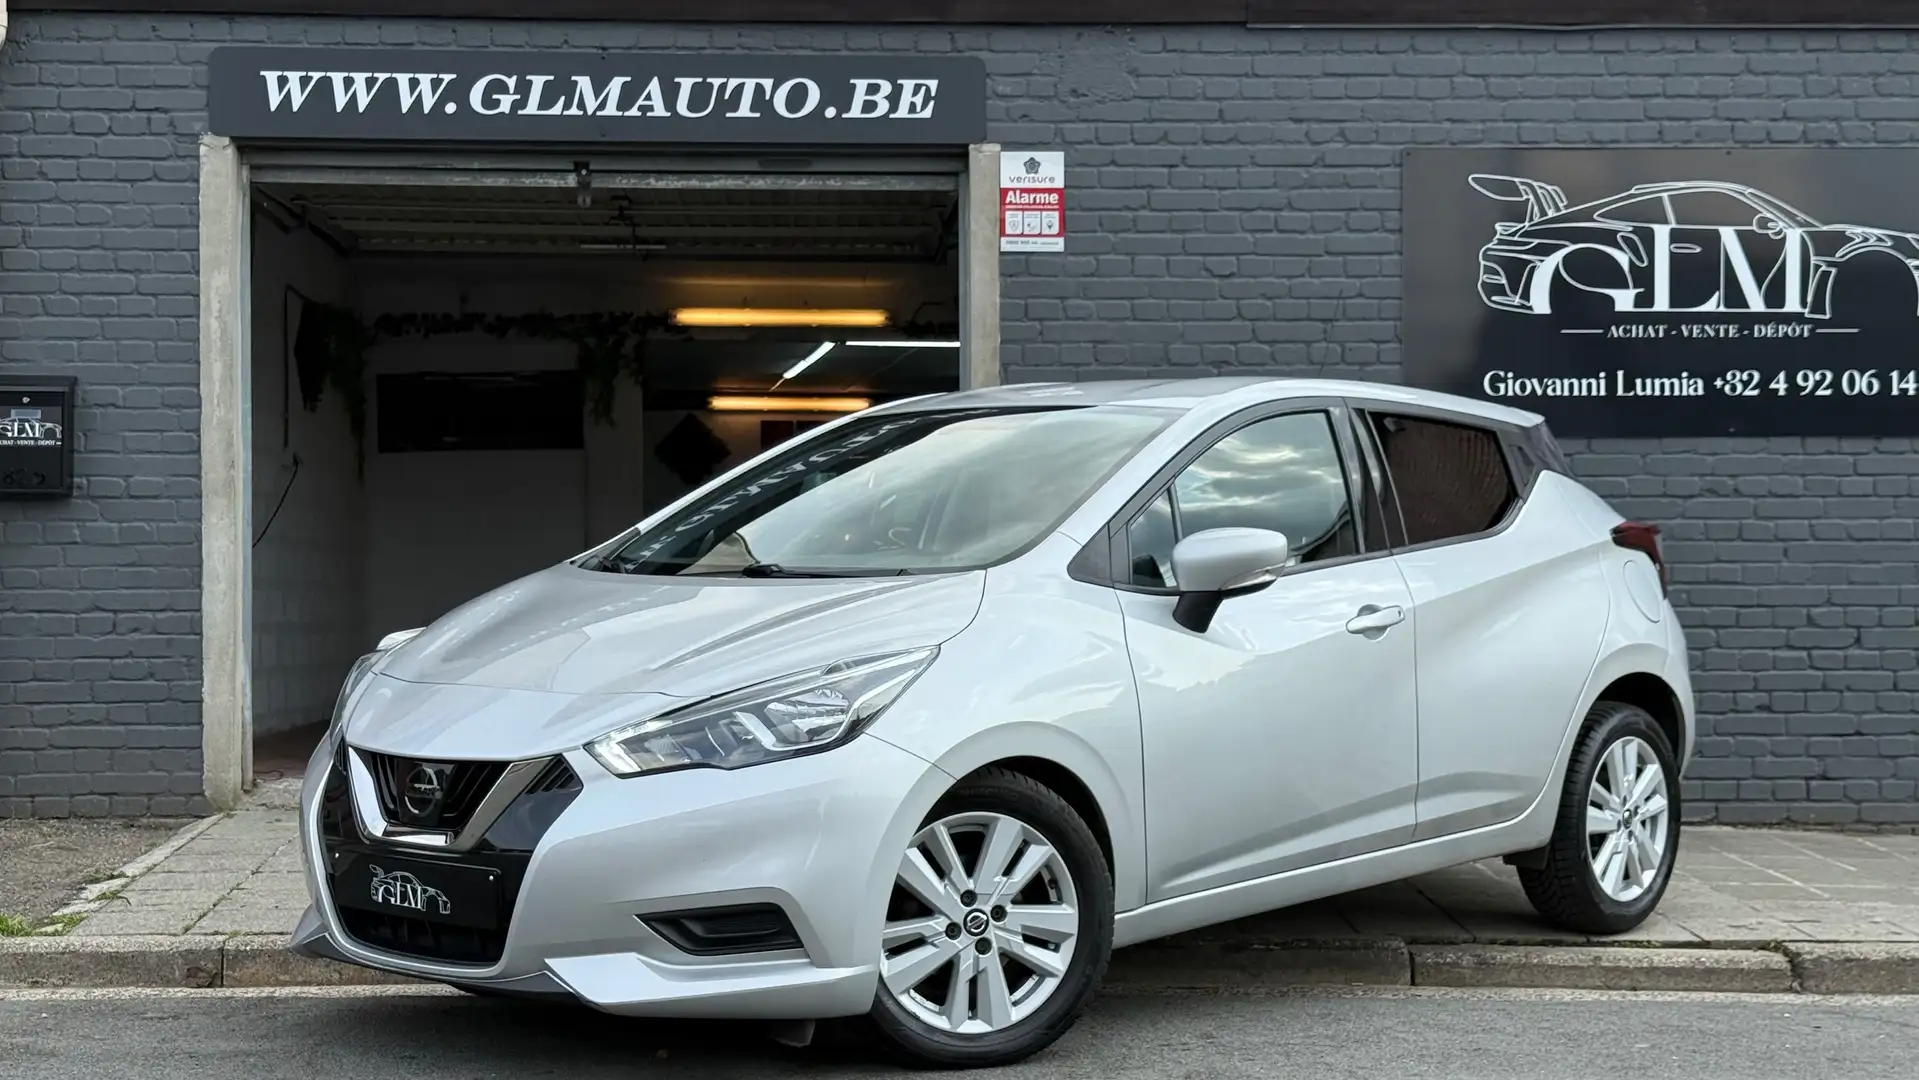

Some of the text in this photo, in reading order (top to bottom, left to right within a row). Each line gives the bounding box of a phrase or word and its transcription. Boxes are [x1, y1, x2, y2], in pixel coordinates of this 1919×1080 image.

[259, 70, 939, 119] WWW.GLMAUTO.BE
[1009, 176, 1056, 184] verisure
[1005, 190, 1059, 204] Alarme
[1529, 225, 1811, 315] GLM
[1607, 324, 1668, 338] ACHAT
[1681, 324, 1740, 338] VENTE
[1753, 321, 1815, 338] DÉPÔT
[1483, 369, 1919, 397] Giovanni Lumia +32 4 92 06 14
